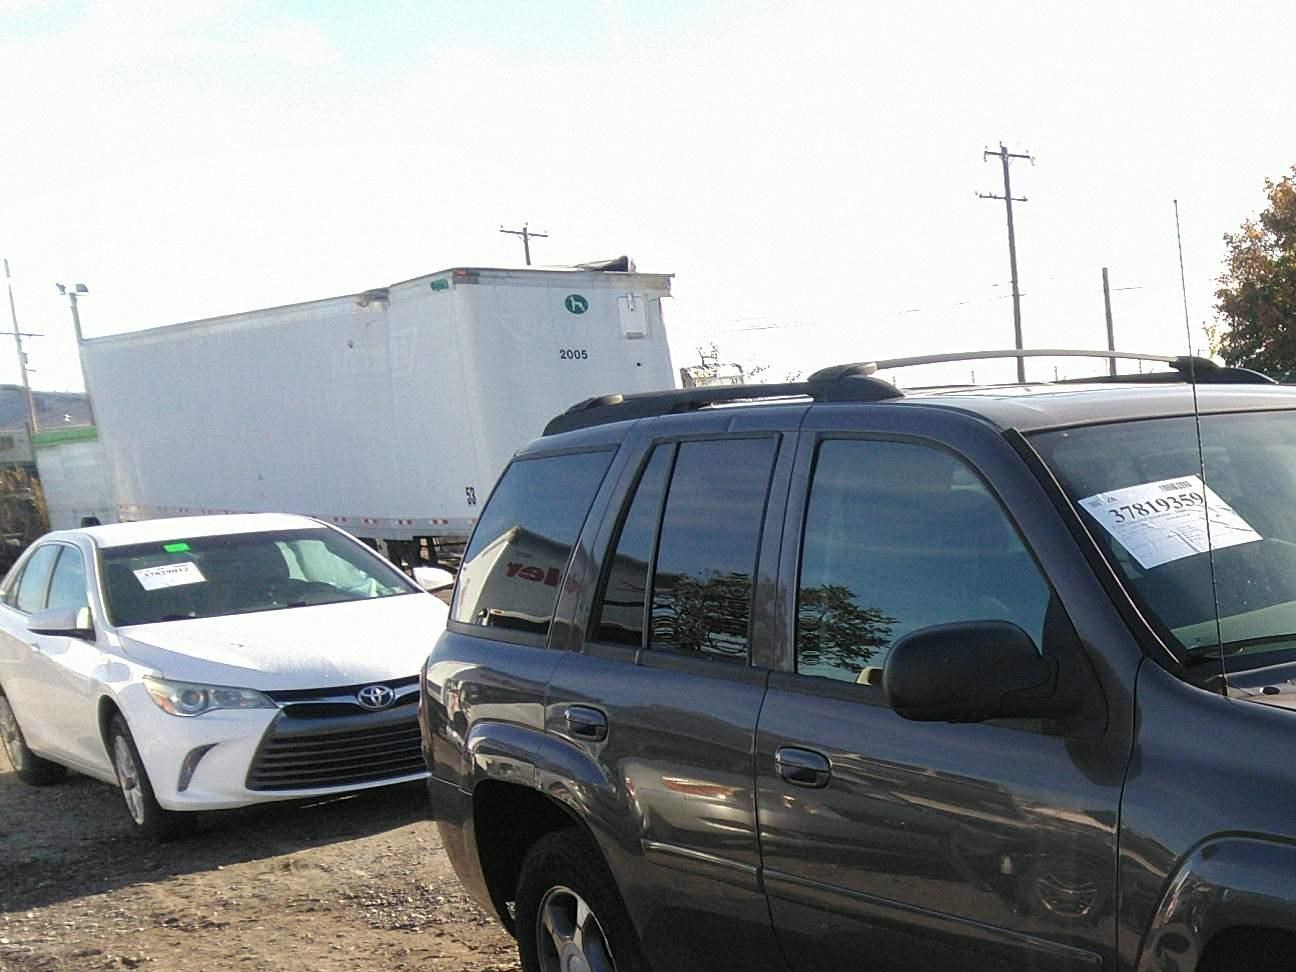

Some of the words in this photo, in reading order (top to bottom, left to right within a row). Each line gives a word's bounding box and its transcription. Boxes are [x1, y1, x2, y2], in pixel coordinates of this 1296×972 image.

[559, 348, 588, 360] 2005
[465, 486, 477, 505] 53
[1108, 491, 1204, 523] 37819359
